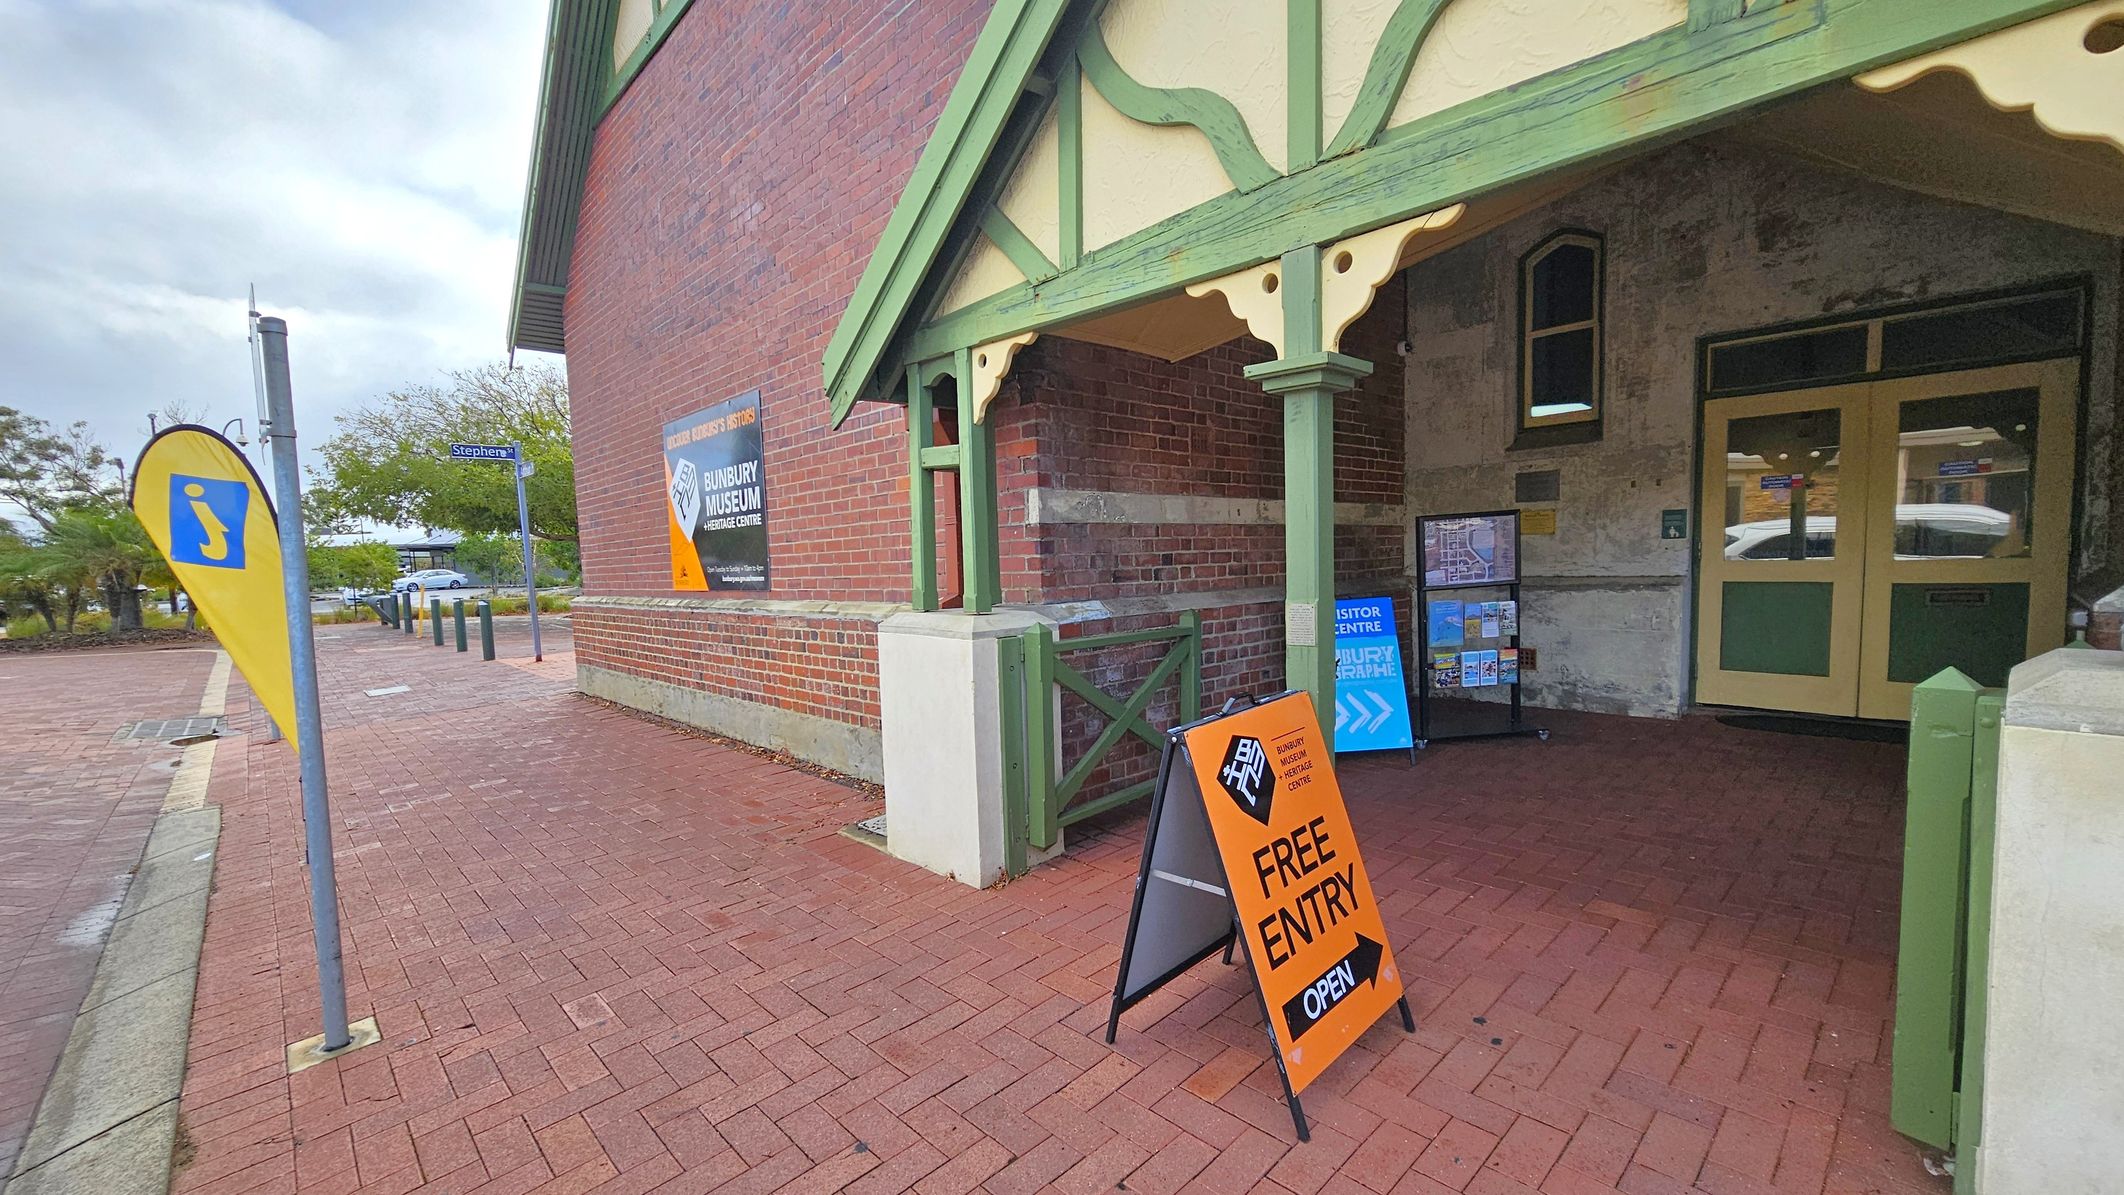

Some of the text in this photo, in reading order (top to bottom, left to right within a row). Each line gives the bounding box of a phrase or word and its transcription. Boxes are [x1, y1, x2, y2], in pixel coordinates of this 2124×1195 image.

[726, 406, 756, 431] HISTORY
[703, 460, 758, 492] BUNBURY
[705, 486, 761, 517] MUSEUM
[736, 513, 762, 528] CENTRE
[1336, 606, 1382, 620] ISITOR
[1276, 736, 1305, 755] BUNBURY
[1280, 749, 1308, 767] MUSEUM
[1284, 760, 1313, 780] HERITAGE
[1287, 774, 1312, 792] CENTRE
[1252, 815, 1337, 900] FREE
[1257, 862, 1359, 971] ENTRY
[1303, 959, 1356, 1020] OPEN
